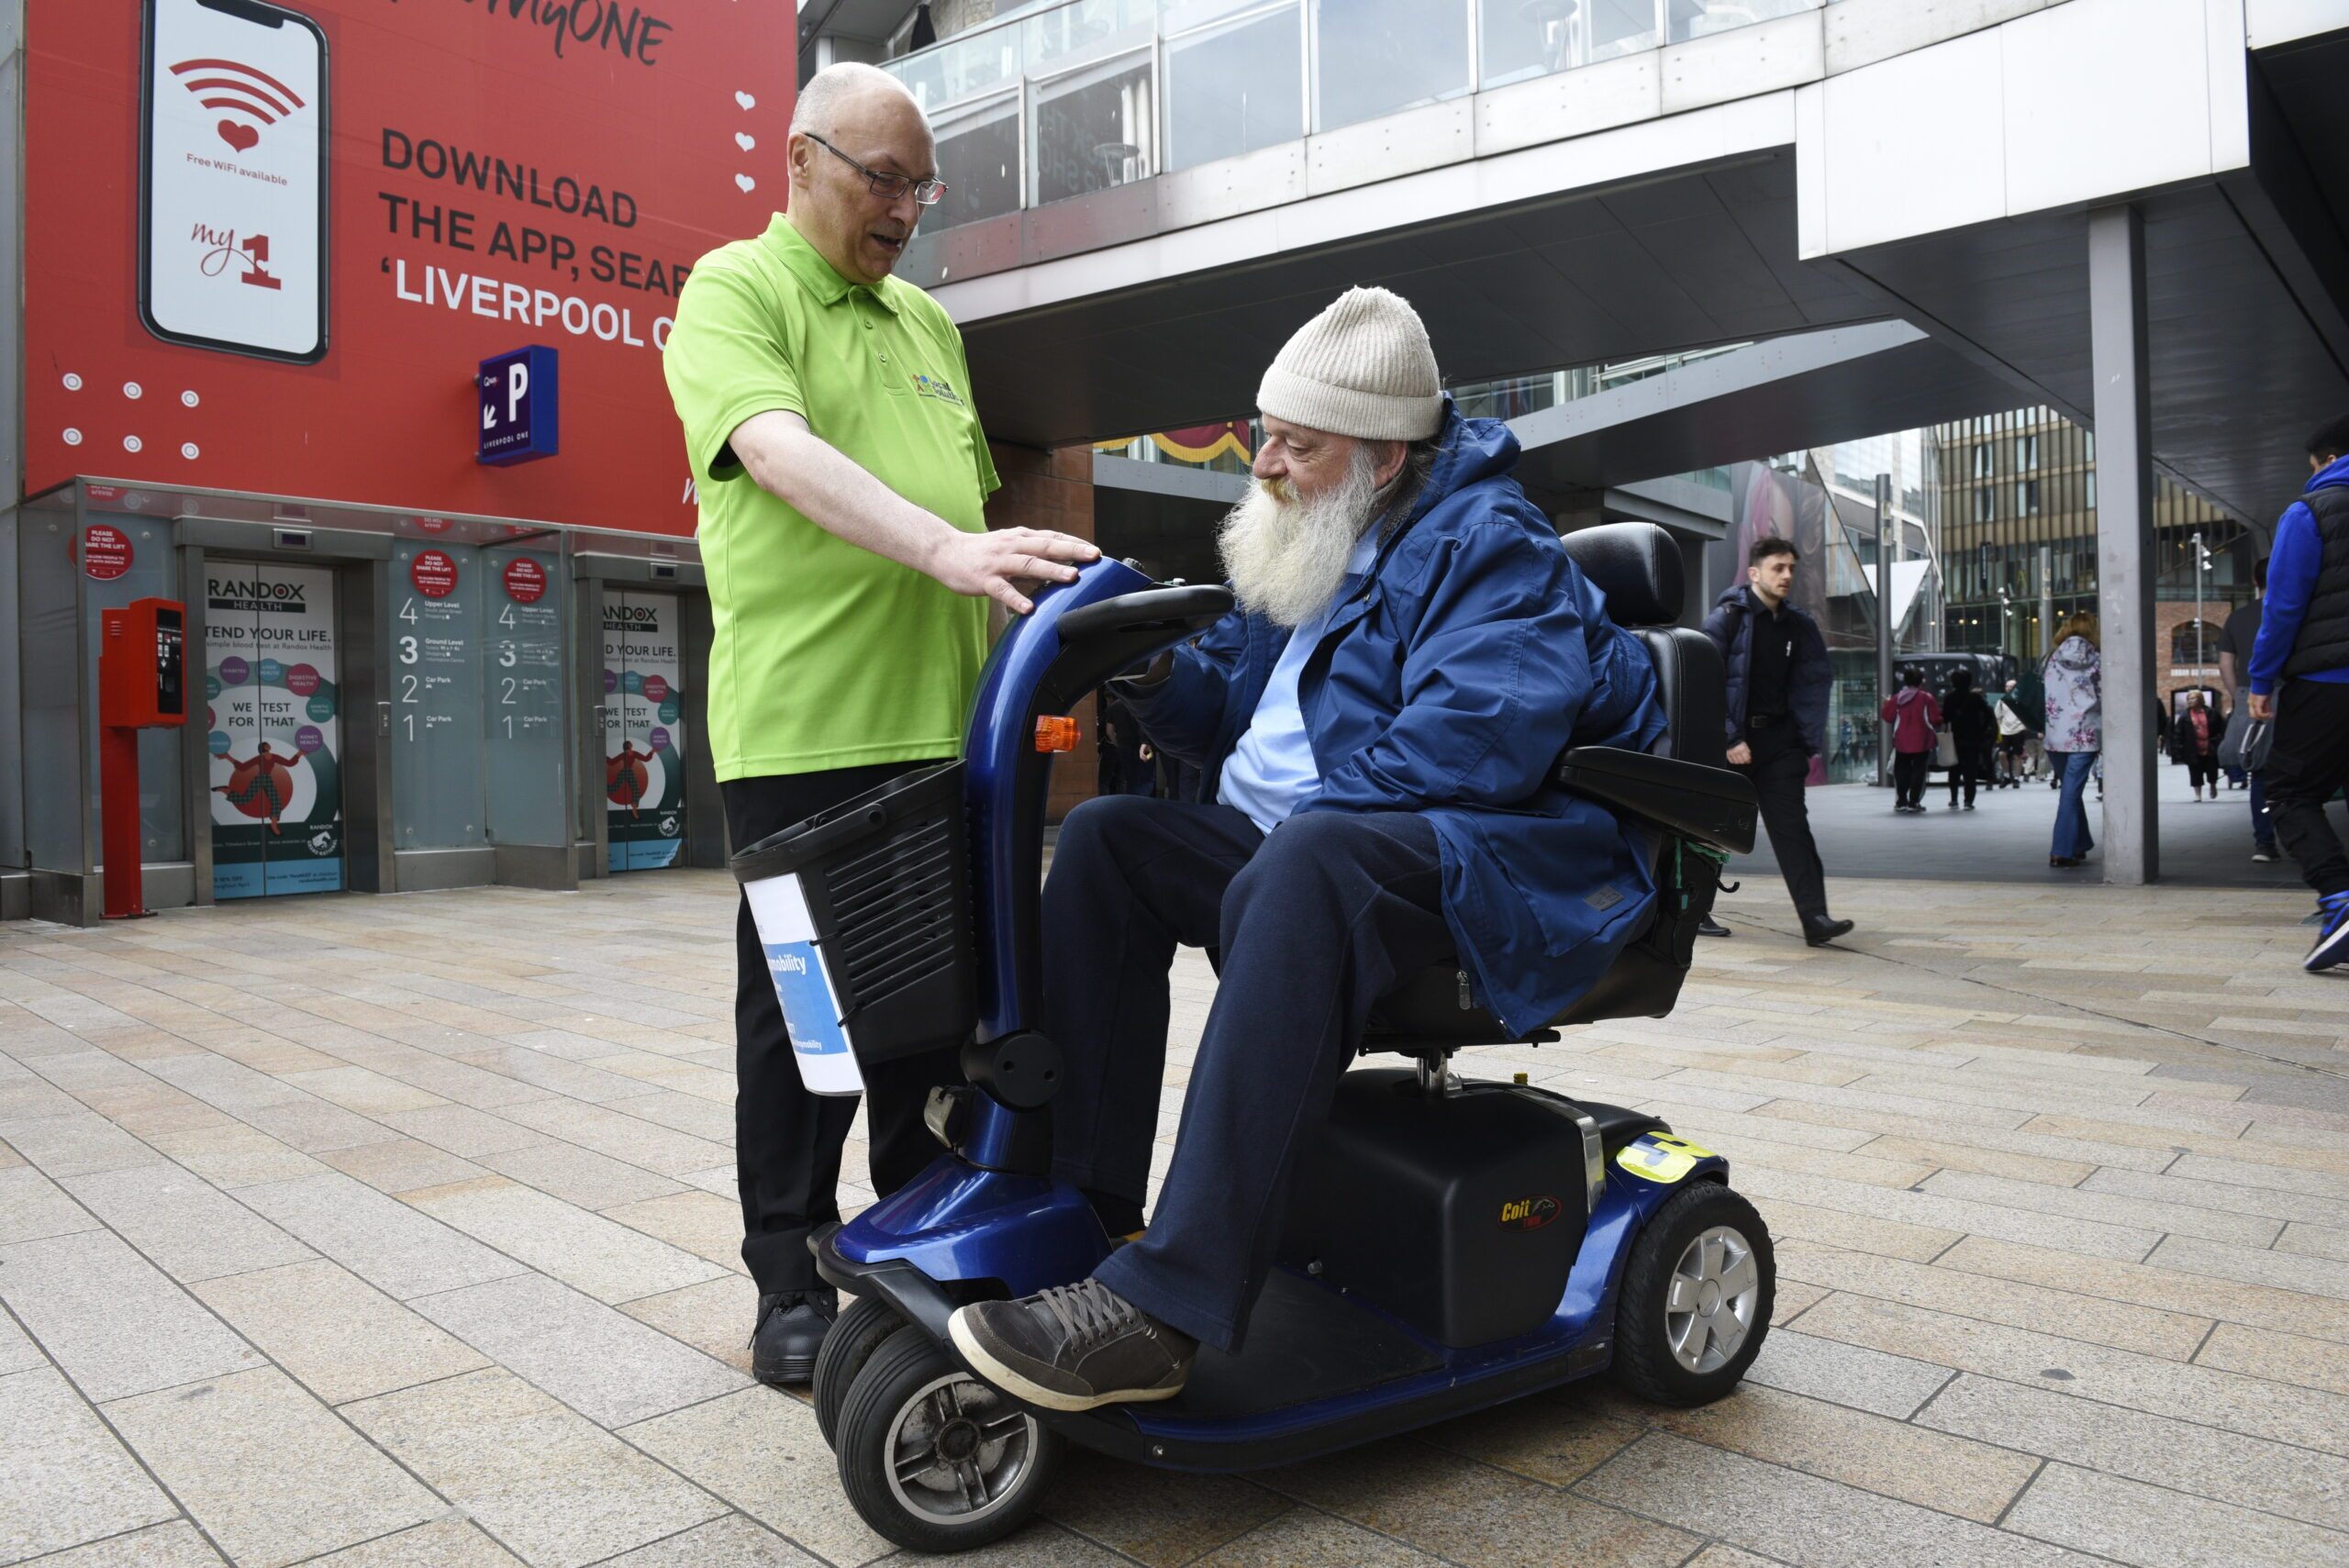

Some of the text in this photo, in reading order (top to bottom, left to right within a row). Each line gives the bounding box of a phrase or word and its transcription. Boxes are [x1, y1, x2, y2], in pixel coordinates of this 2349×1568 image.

[186, 153, 287, 185] Free WiFi available
[382, 128, 637, 228] DOWNLOAD
[378, 191, 475, 251] THE
[487, 221, 579, 282] APP,
[509, 362, 529, 422] P
[484, 430, 529, 450] LIVERPOOL ONE
[207, 578, 305, 601] RANDOX
[233, 600, 283, 612] HEALTH
[399, 597, 418, 625] 4
[499, 604, 517, 629] 4
[250, 628, 295, 640] YOUR
[298, 629, 332, 642] LIFE.
[605, 622, 641, 631] HEALTH
[399, 636, 418, 664] 3
[617, 645, 650, 656] YOUR
[652, 646, 676, 657] LIFE.
[402, 674, 418, 703] 2
[501, 677, 517, 705] 2
[232, 702, 291, 713] WE TEST
[625, 707, 648, 717] TEST
[228, 717, 295, 728] FOR THAT
[403, 714, 413, 741] 1
[503, 716, 512, 740] 1
[626, 719, 651, 728] THAT
